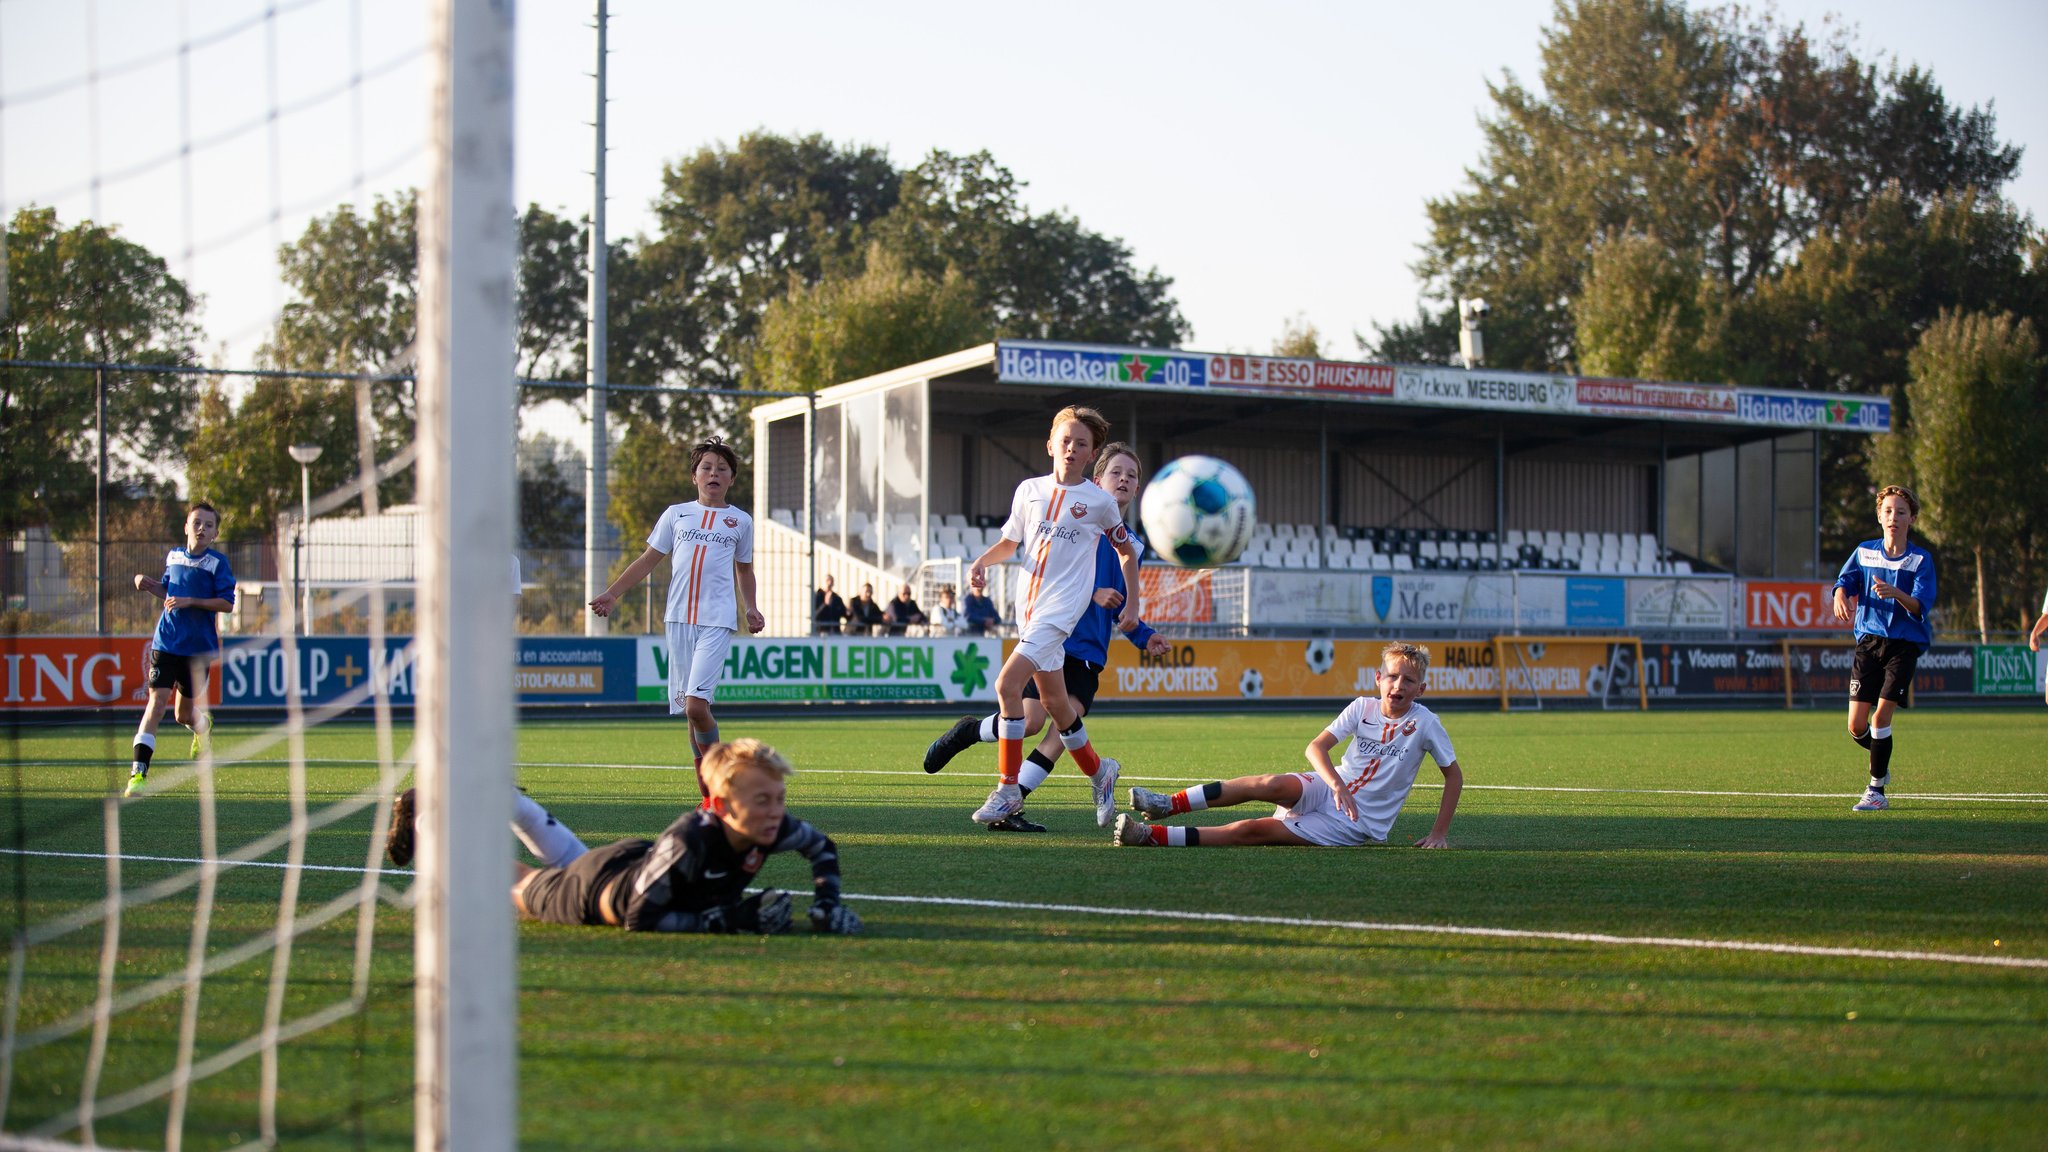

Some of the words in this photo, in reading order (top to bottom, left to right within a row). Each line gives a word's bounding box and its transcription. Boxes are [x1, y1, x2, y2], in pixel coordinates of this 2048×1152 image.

[1001, 348, 1121, 382] Heineken
[1266, 358, 1311, 385] ESSO
[1315, 362, 1394, 391] HUISMAN
[1424, 378, 1464, 399] r.k.v.v.
[1467, 379, 1548, 403] MEERBURG
[1578, 384, 1632, 403] HUISMAN
[1738, 395, 1827, 424] Heineken
[1399, 591, 1459, 620] Meer
[1751, 591, 1814, 627] ING
[539, 649, 604, 664] accountants
[652, 645, 825, 680] VHAGEN
[830, 645, 934, 680] LEIDEN
[1445, 646, 1494, 667] HALLO
[1689, 649, 1737, 668] Vloeren
[3, 652, 127, 703] ING
[227, 647, 330, 698] STOLP
[513, 672, 596, 689] .STOLPKAB.NL
[1116, 666, 1219, 692] TOPSPORTERS
[1424, 666, 1501, 691] ETERWOUDE
[831, 686, 937, 699] ELEKTROTREKKERS
